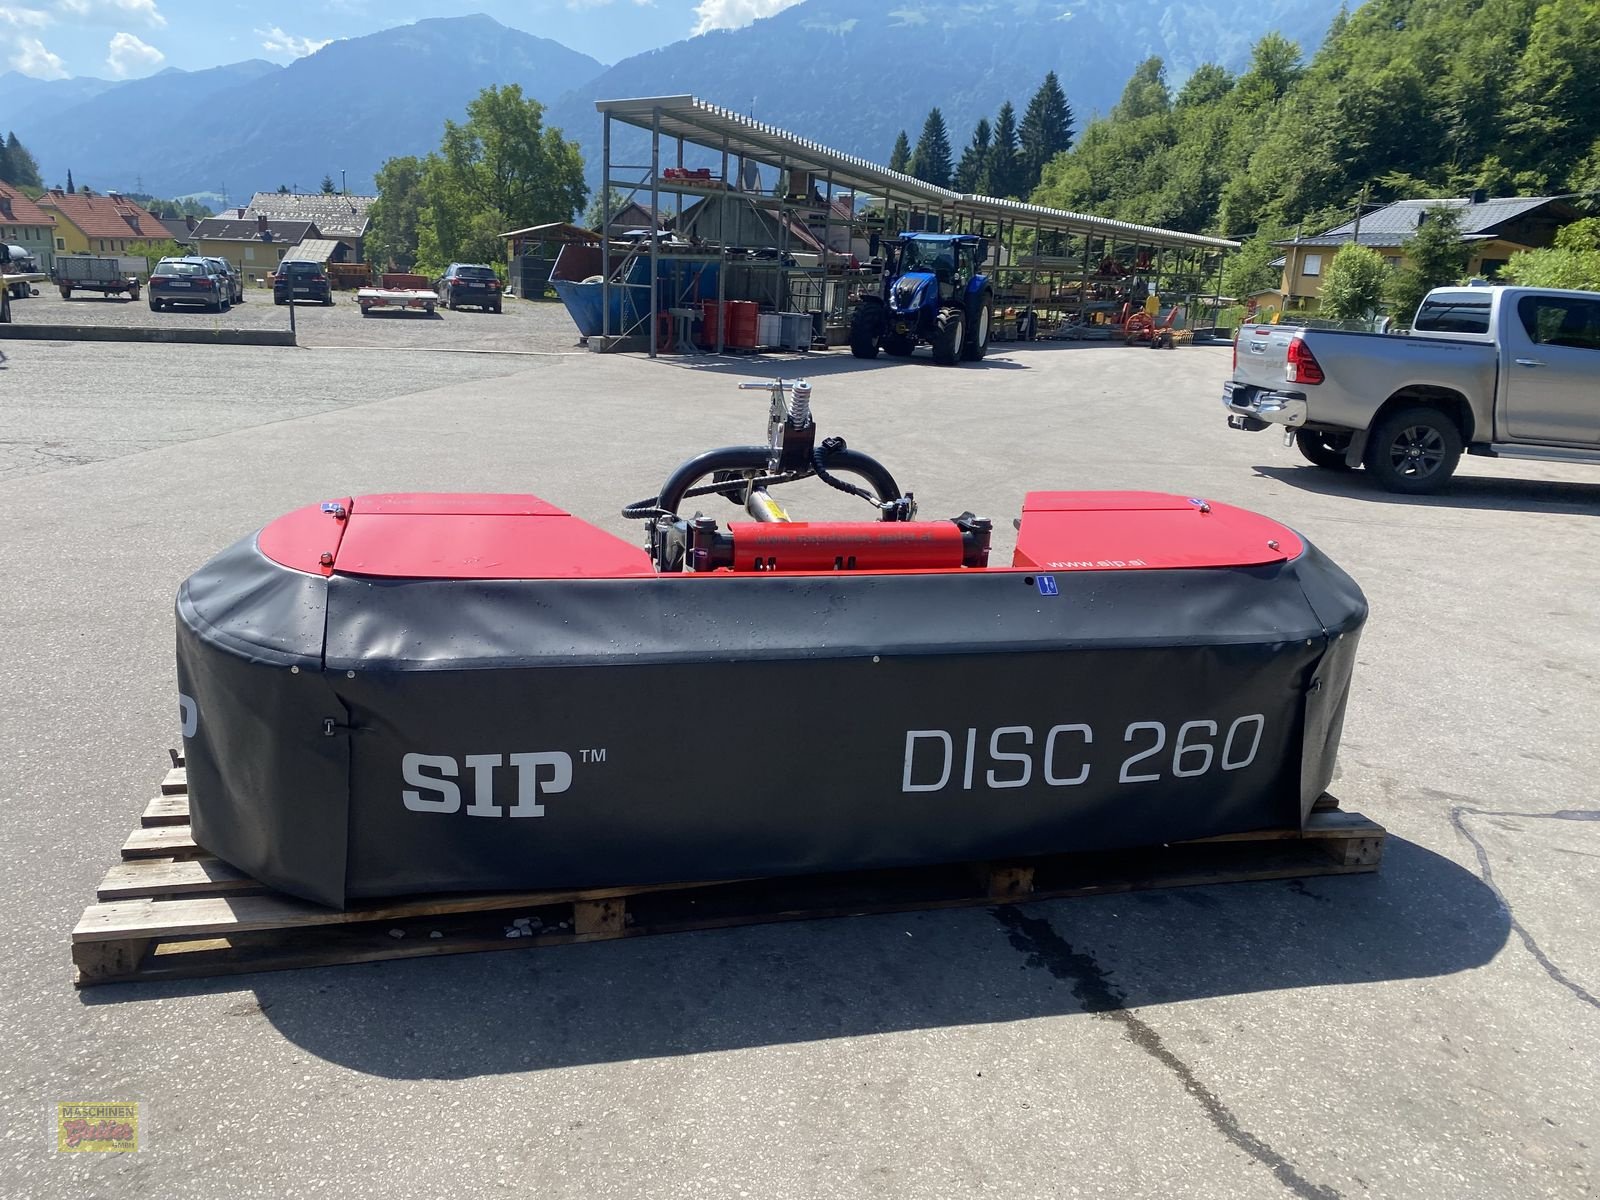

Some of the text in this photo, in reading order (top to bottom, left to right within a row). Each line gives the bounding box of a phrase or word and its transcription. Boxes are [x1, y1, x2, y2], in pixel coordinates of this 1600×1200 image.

[1047, 559, 1147, 568] www.sip.si
[402, 751, 573, 818] SIP
[902, 713, 1265, 792] DISC 260
